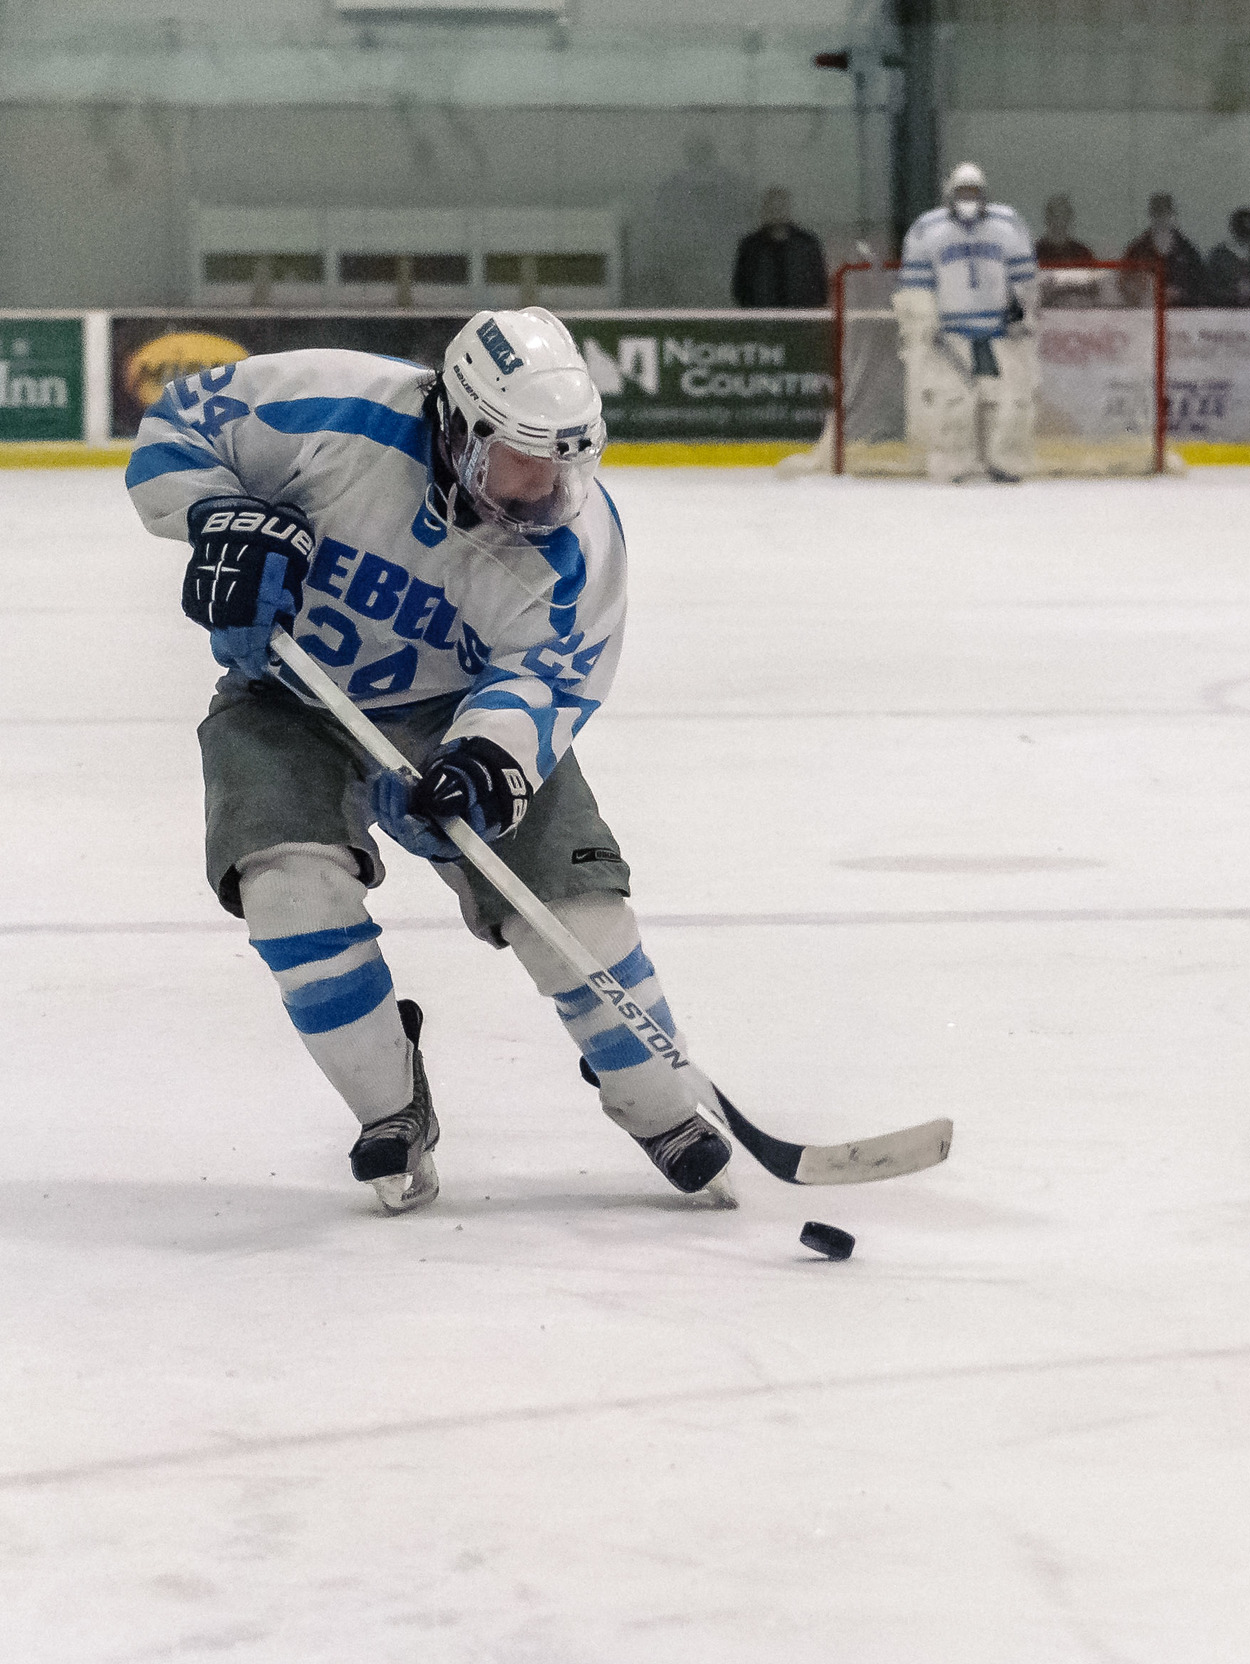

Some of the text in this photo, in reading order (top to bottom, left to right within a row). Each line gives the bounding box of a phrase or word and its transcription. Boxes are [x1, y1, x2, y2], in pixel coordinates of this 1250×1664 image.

[680, 367, 836, 398] COUNTR
[200, 511, 313, 562] BAUE
[305, 536, 493, 676] EBELS
[295, 604, 419, 700] 24
[521, 630, 612, 688] 24
[589, 970, 689, 1070] EASTON
